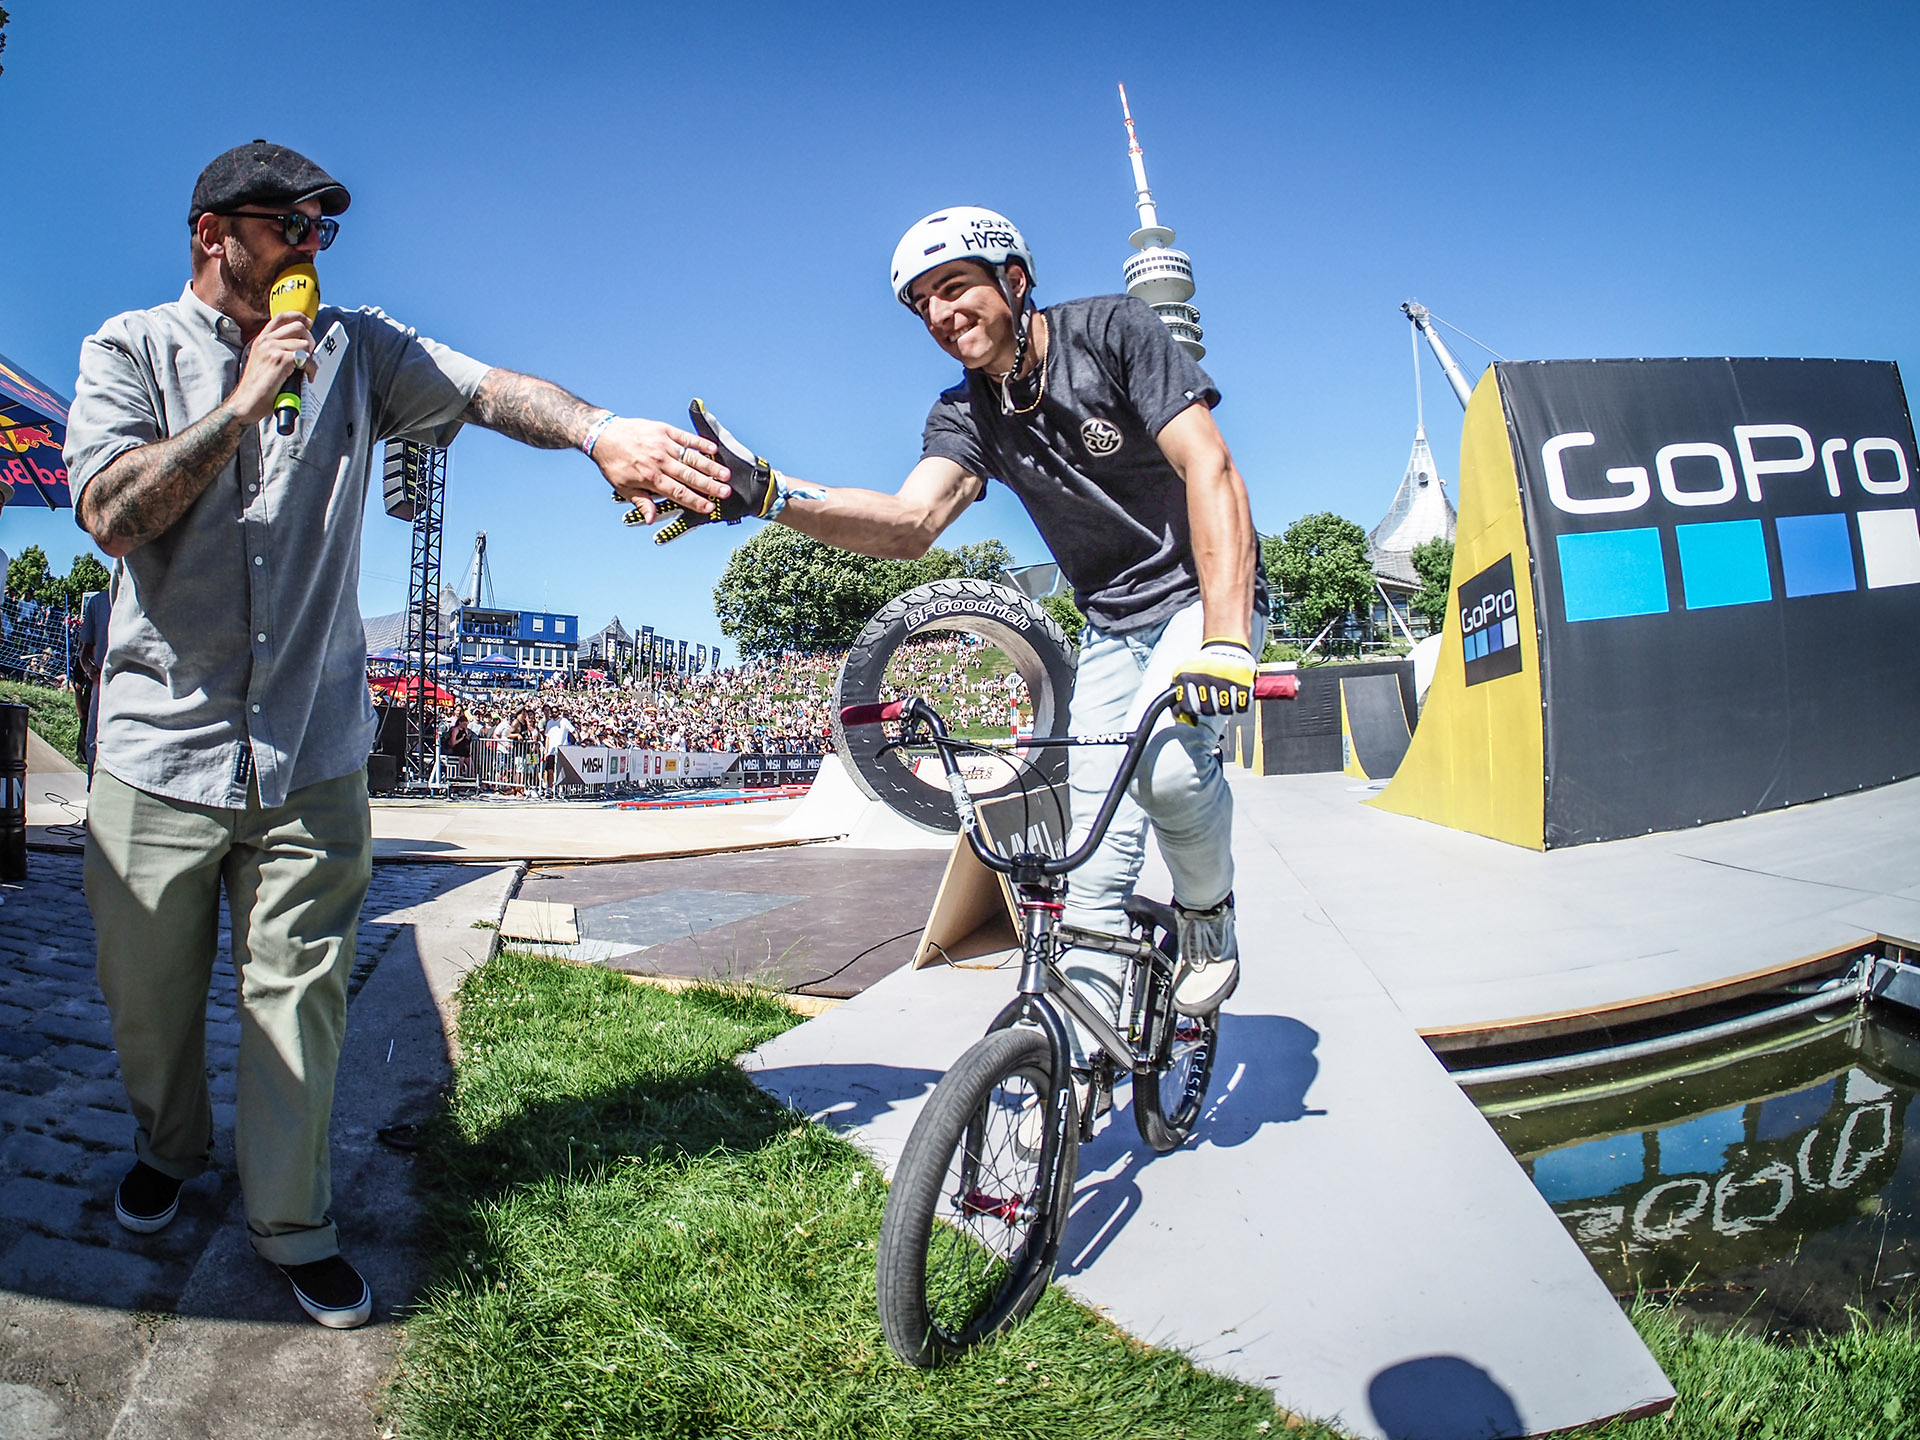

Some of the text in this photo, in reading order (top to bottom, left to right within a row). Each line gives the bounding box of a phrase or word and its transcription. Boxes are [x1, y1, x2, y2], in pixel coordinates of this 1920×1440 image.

[961, 231, 1019, 251] HYPER
[1541, 423, 1910, 515] GoPro
[903, 599, 1032, 632] BFGoodrich
[1461, 588, 1515, 634] GoPro
[479, 637, 504, 645] JUDGES
[581, 757, 604, 774] MASH
